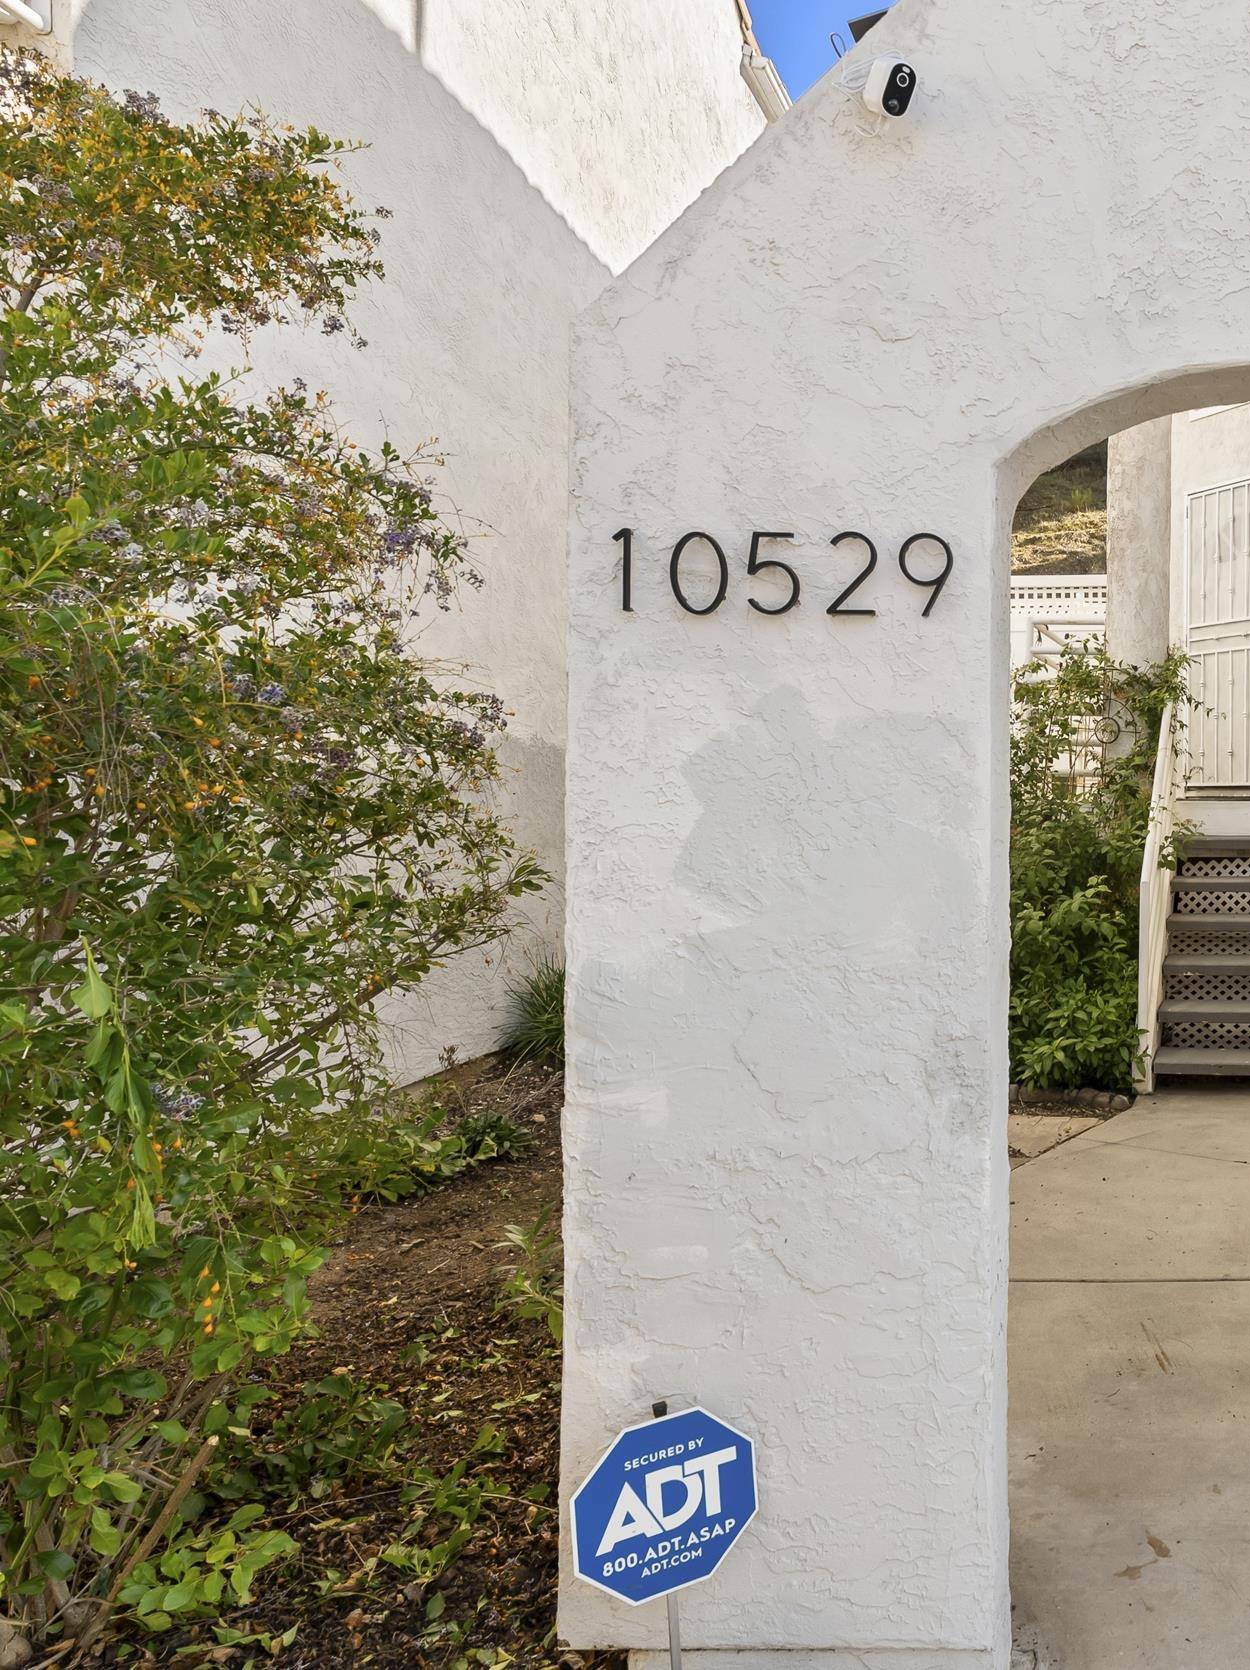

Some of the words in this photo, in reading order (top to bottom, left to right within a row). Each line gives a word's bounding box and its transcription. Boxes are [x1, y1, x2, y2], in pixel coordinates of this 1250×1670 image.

[611, 527, 954, 617] 10529
[623, 1444, 685, 1471] SECURED
[688, 1437, 704, 1451] BY
[595, 1445, 737, 1558] ADT
[602, 1518, 736, 1577] 800.ADT.ASAP
[640, 1547, 703, 1578] ADT.COM
